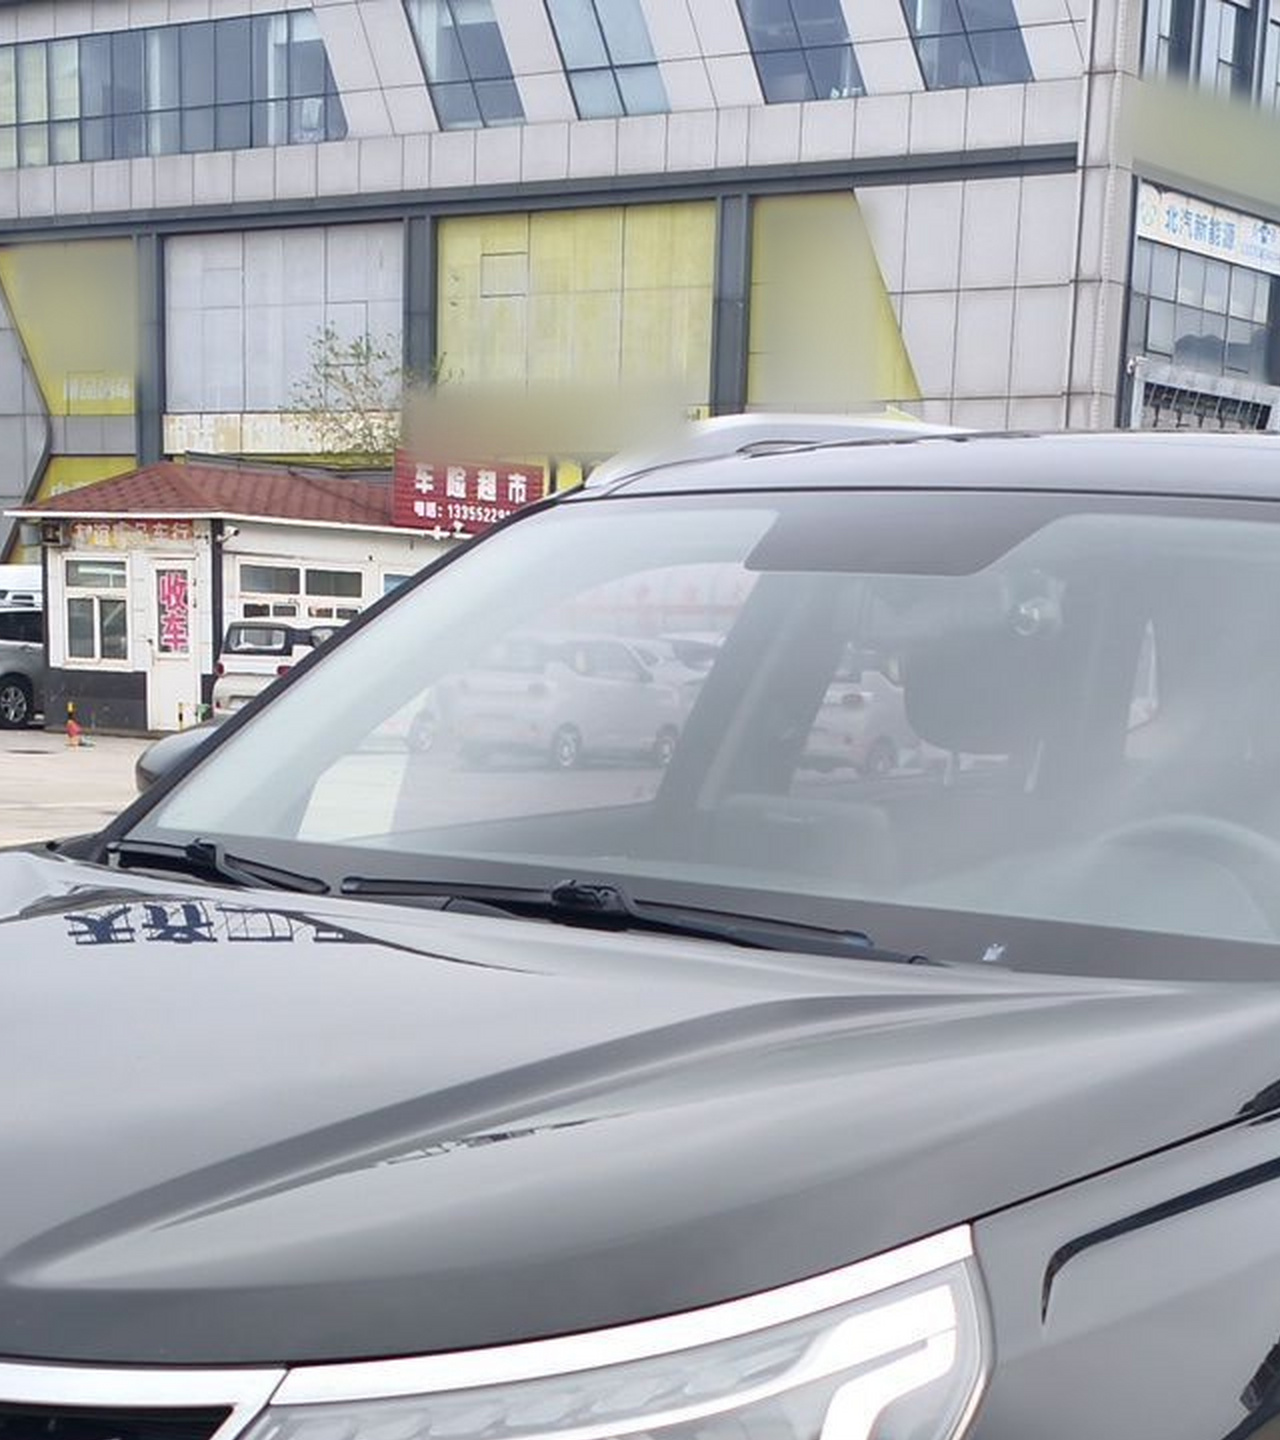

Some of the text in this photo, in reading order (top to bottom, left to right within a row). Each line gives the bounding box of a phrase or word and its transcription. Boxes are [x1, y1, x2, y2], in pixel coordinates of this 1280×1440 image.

[1164, 206, 1236, 249] 北汽新能源
[414, 463, 527, 504] 车险超市
[160, 572, 188, 652] 收车
